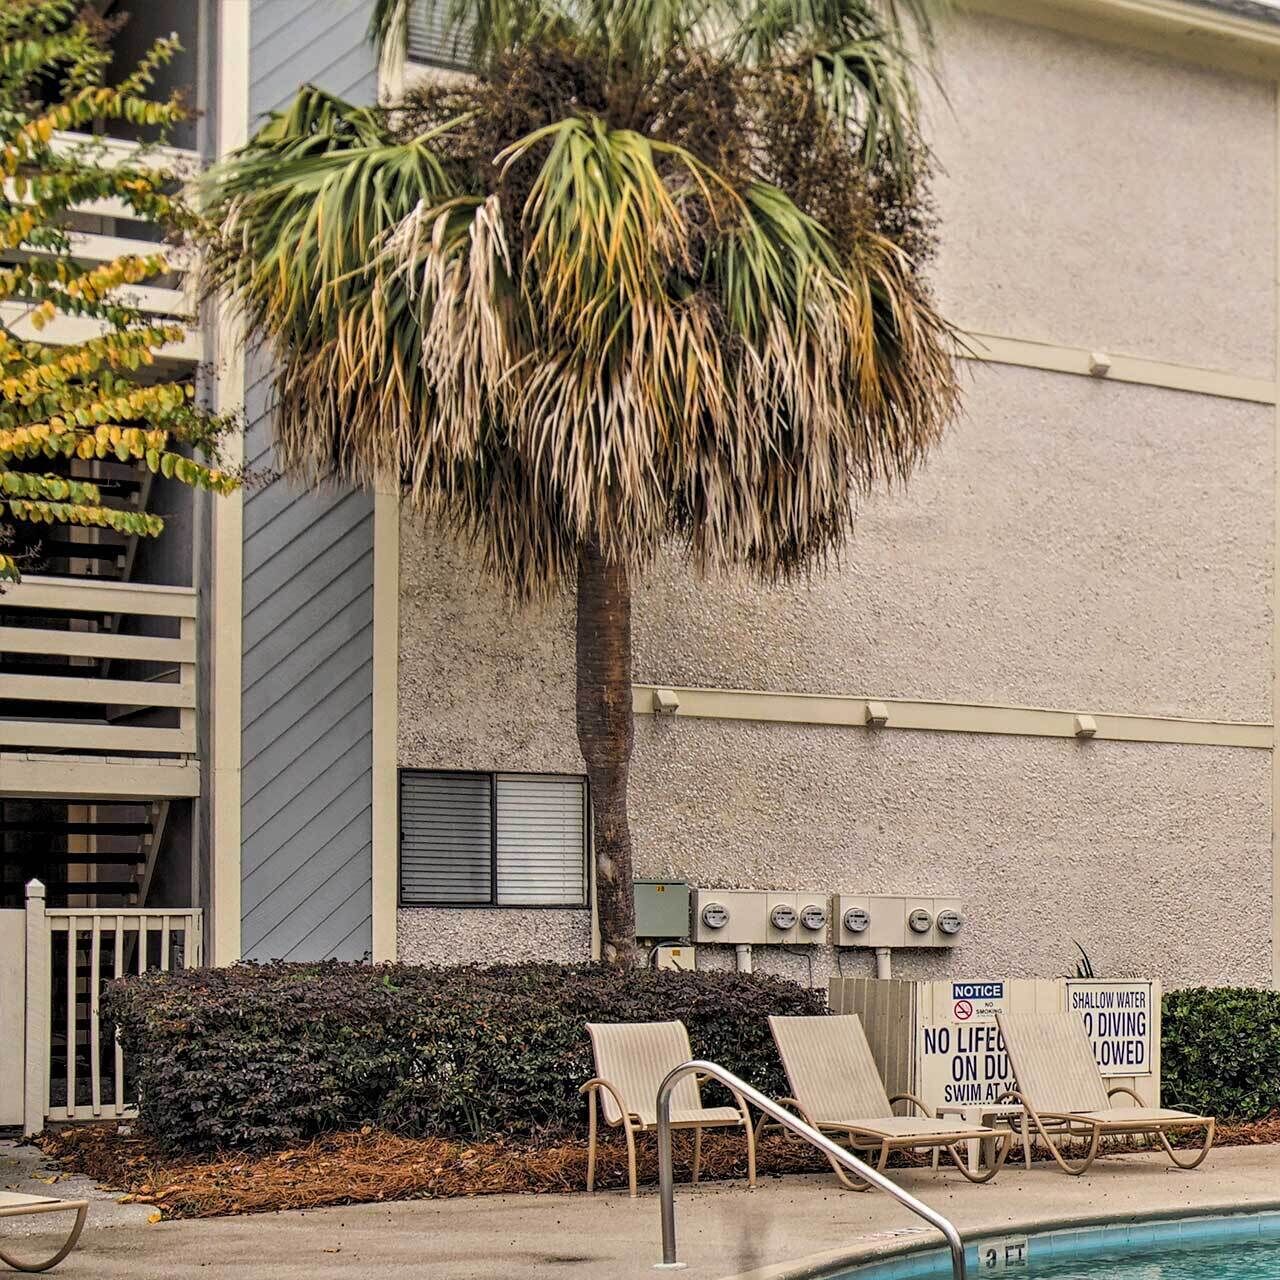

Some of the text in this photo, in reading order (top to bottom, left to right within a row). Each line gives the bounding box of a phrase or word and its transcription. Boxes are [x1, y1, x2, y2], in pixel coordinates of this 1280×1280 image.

[955, 985, 1001, 997] NOTICE
[1072, 991, 1146, 1009] SHALLOW WATER
[1083, 1012, 1146, 1037] O DIVING
[925, 1027, 950, 1054] NO
[1093, 1040, 1144, 1066] LOWED
[952, 1054, 1013, 1082] ON DU
[944, 1083, 982, 1102] SWIM
[985, 1083, 1000, 1101] AT
